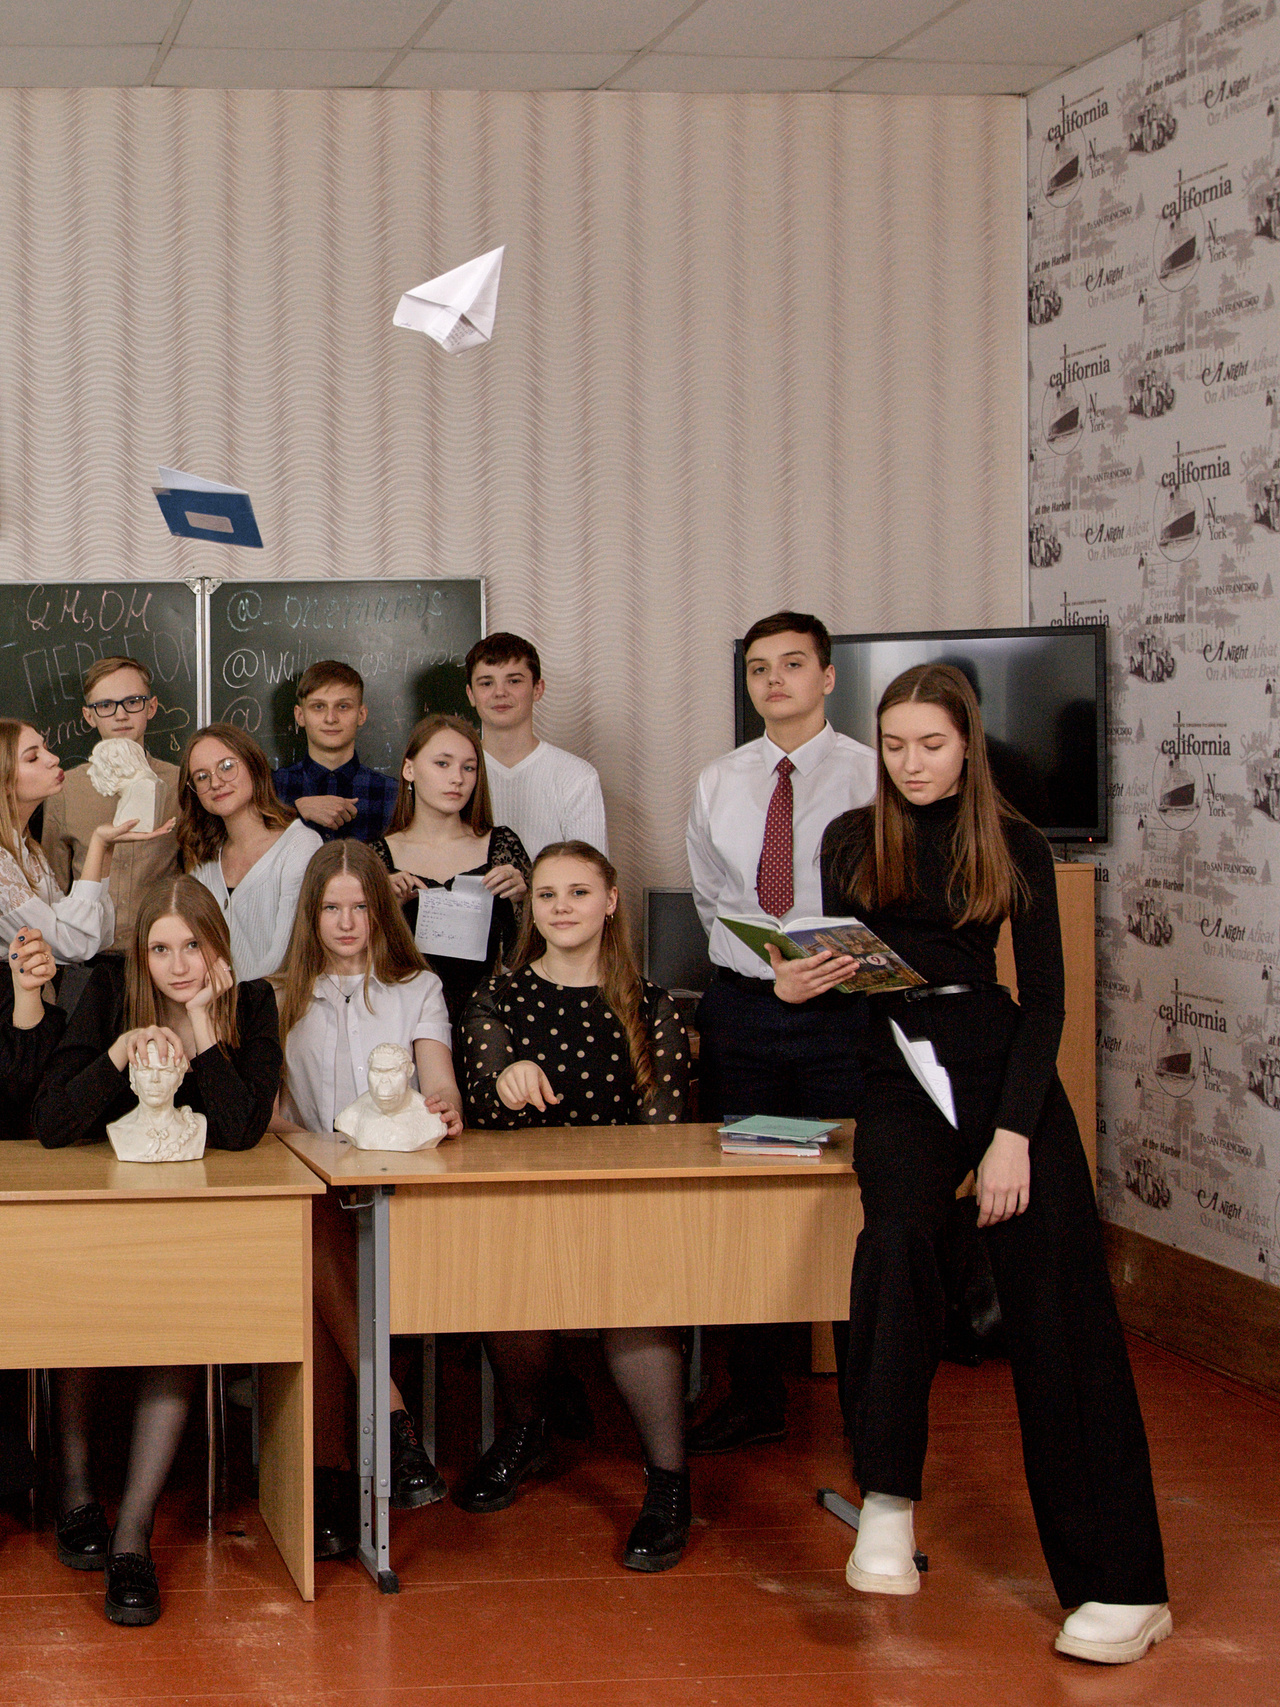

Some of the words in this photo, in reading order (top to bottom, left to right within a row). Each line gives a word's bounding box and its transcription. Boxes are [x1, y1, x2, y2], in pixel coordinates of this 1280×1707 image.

[1048, 95, 1109, 142] california
[1162, 169, 1232, 219] california
[1049, 344, 1111, 388] california
[1223, 360, 1249, 381] Night
[1161, 441, 1231, 488] california
[1104, 525, 1125, 543] Night
[1208, 525, 1227, 540] York
[1224, 644, 1249, 663] Night
[1161, 711, 1231, 756] california
[1207, 801, 1227, 817] York
[1221, 924, 1246, 943] Night
[1158, 978, 1227, 1034] california
[1218, 1200, 1243, 1220] Night
